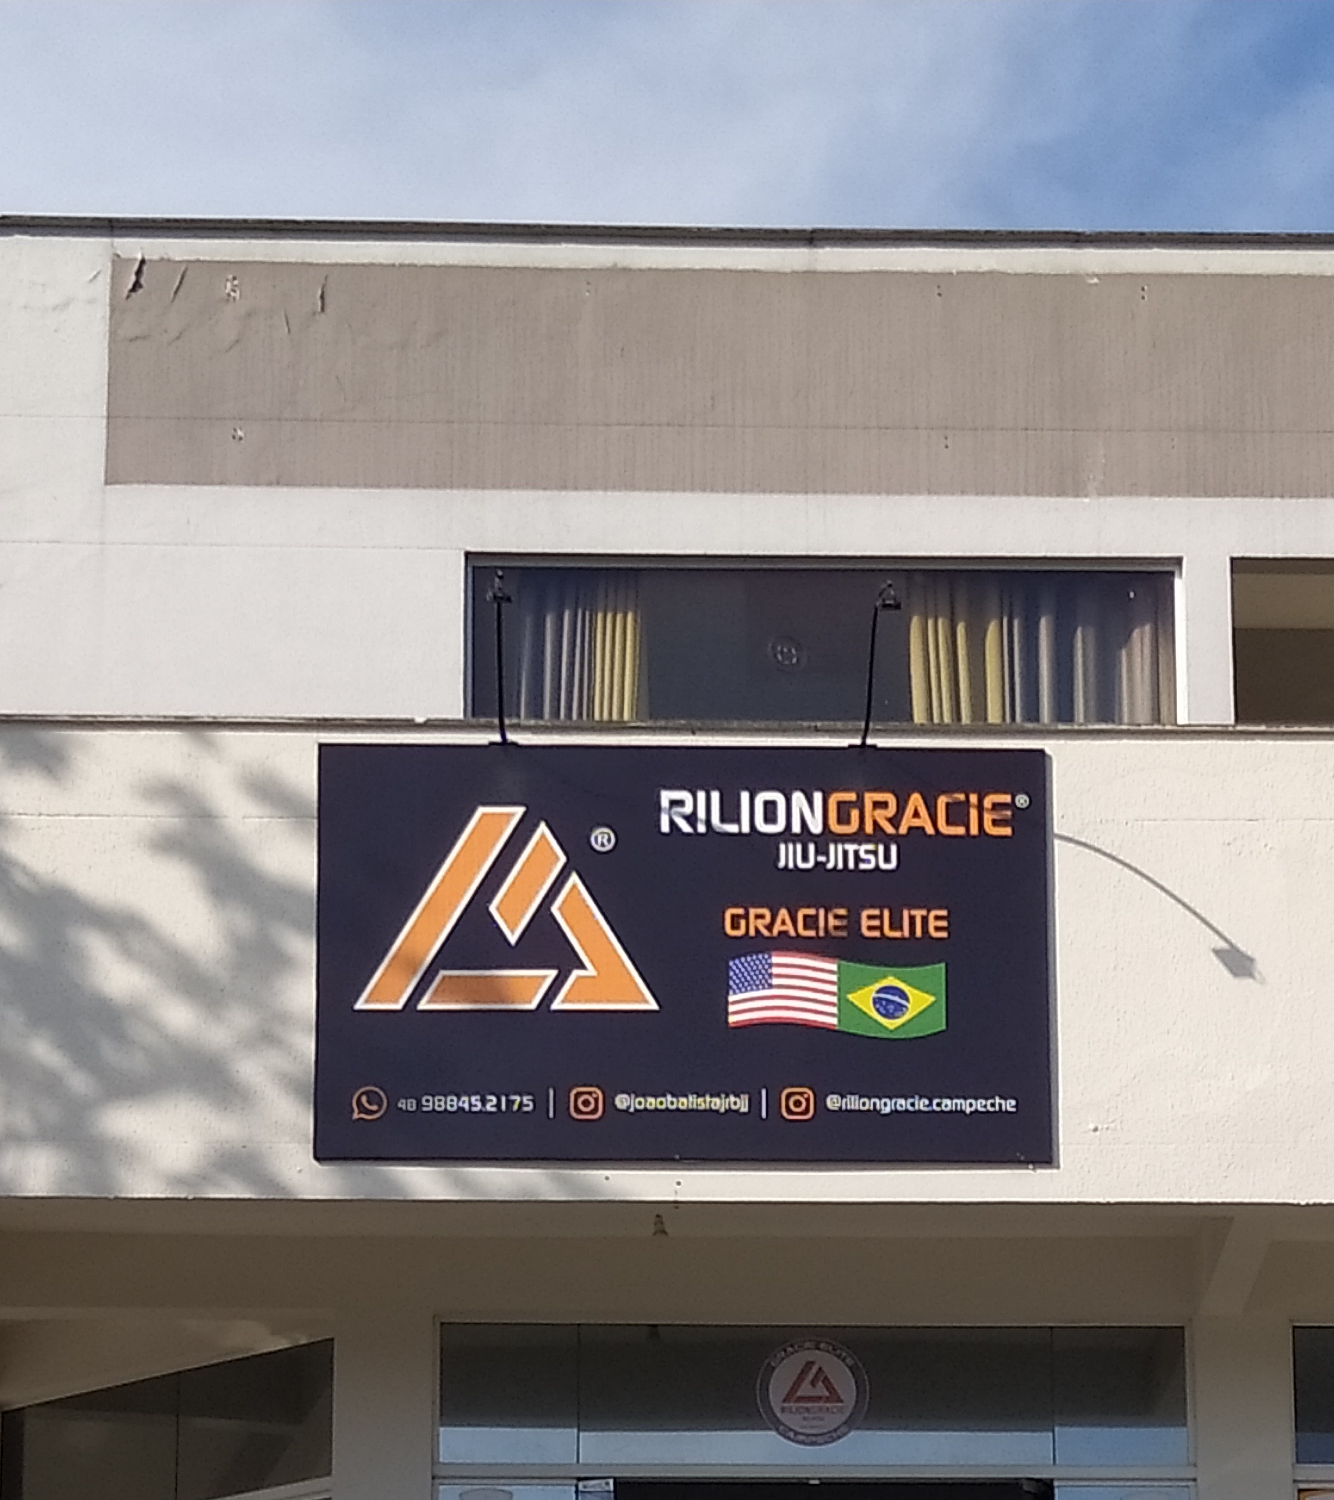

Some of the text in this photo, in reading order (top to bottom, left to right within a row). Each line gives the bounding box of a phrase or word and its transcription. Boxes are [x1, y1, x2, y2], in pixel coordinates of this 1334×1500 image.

[778, 843, 898, 870] JIU-JITSU
[724, 907, 949, 938] GRACIE ELITE
[397, 1095, 534, 1112] 48 98845.2175
[826, 1094, 1017, 1114] @riliongracie.campeche
